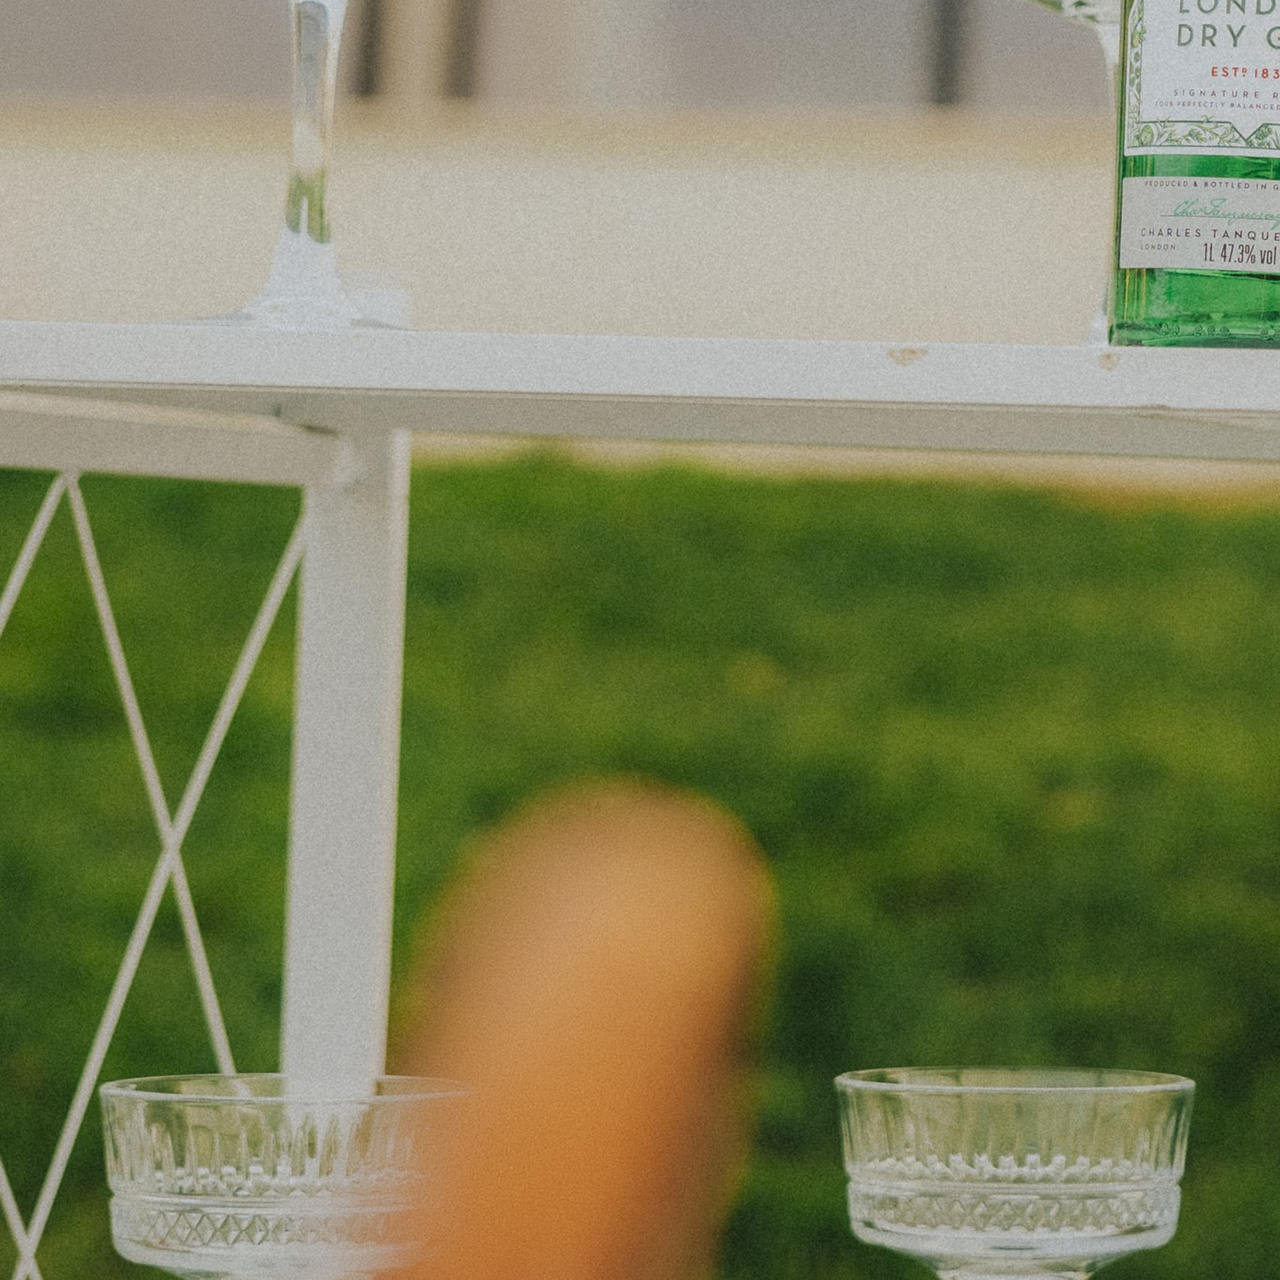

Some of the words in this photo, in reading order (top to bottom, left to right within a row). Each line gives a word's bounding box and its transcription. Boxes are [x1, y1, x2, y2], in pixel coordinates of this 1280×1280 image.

[1177, 24, 1247, 47] DRY
[1173, 88, 1260, 99] SIGNATURE
[1144, 180, 1188, 188] PRODUCED
[1203, 181, 1250, 189] BOTTLED
[1141, 228, 1201, 238] CHARLES
[1203, 242, 1215, 263] 1L
[1220, 243, 1257, 265] 47.3%
[1260, 245, 1277, 266] vol
